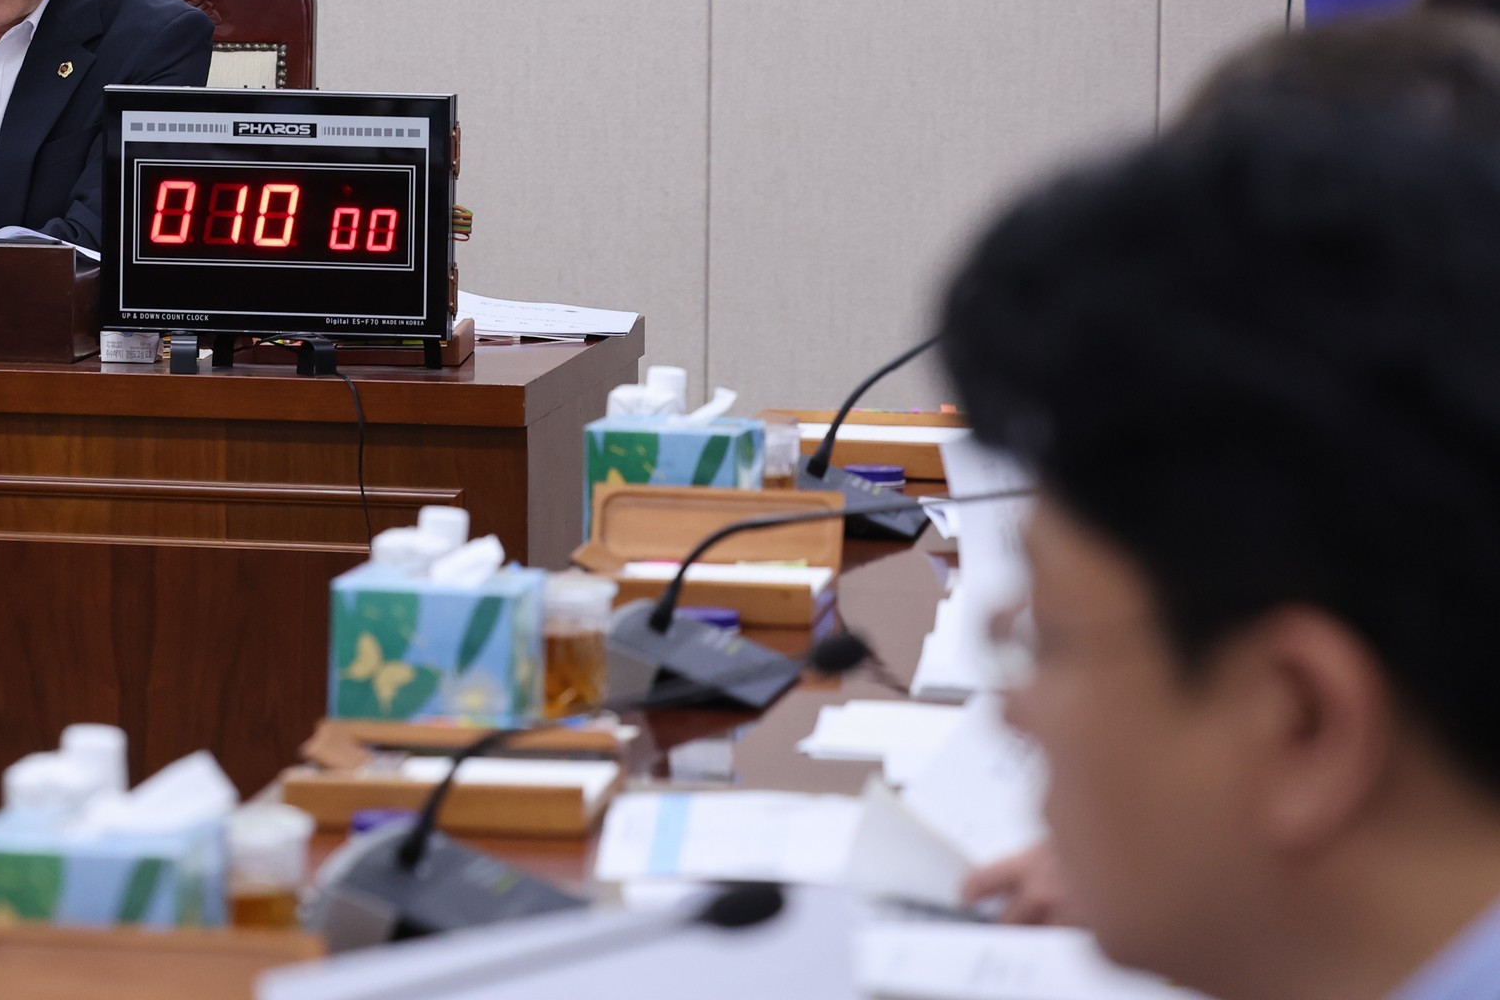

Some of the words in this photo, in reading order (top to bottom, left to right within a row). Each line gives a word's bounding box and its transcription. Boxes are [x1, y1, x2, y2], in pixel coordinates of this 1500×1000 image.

[238, 123, 311, 135] PHAROS
[150, 180, 301, 248] 010
[328, 207, 398, 252] 00
[121, 312, 131, 320] UP
[139, 312, 160, 320] DOWN
[161, 313, 185, 321] COUNT
[325, 317, 349, 326] Digital
